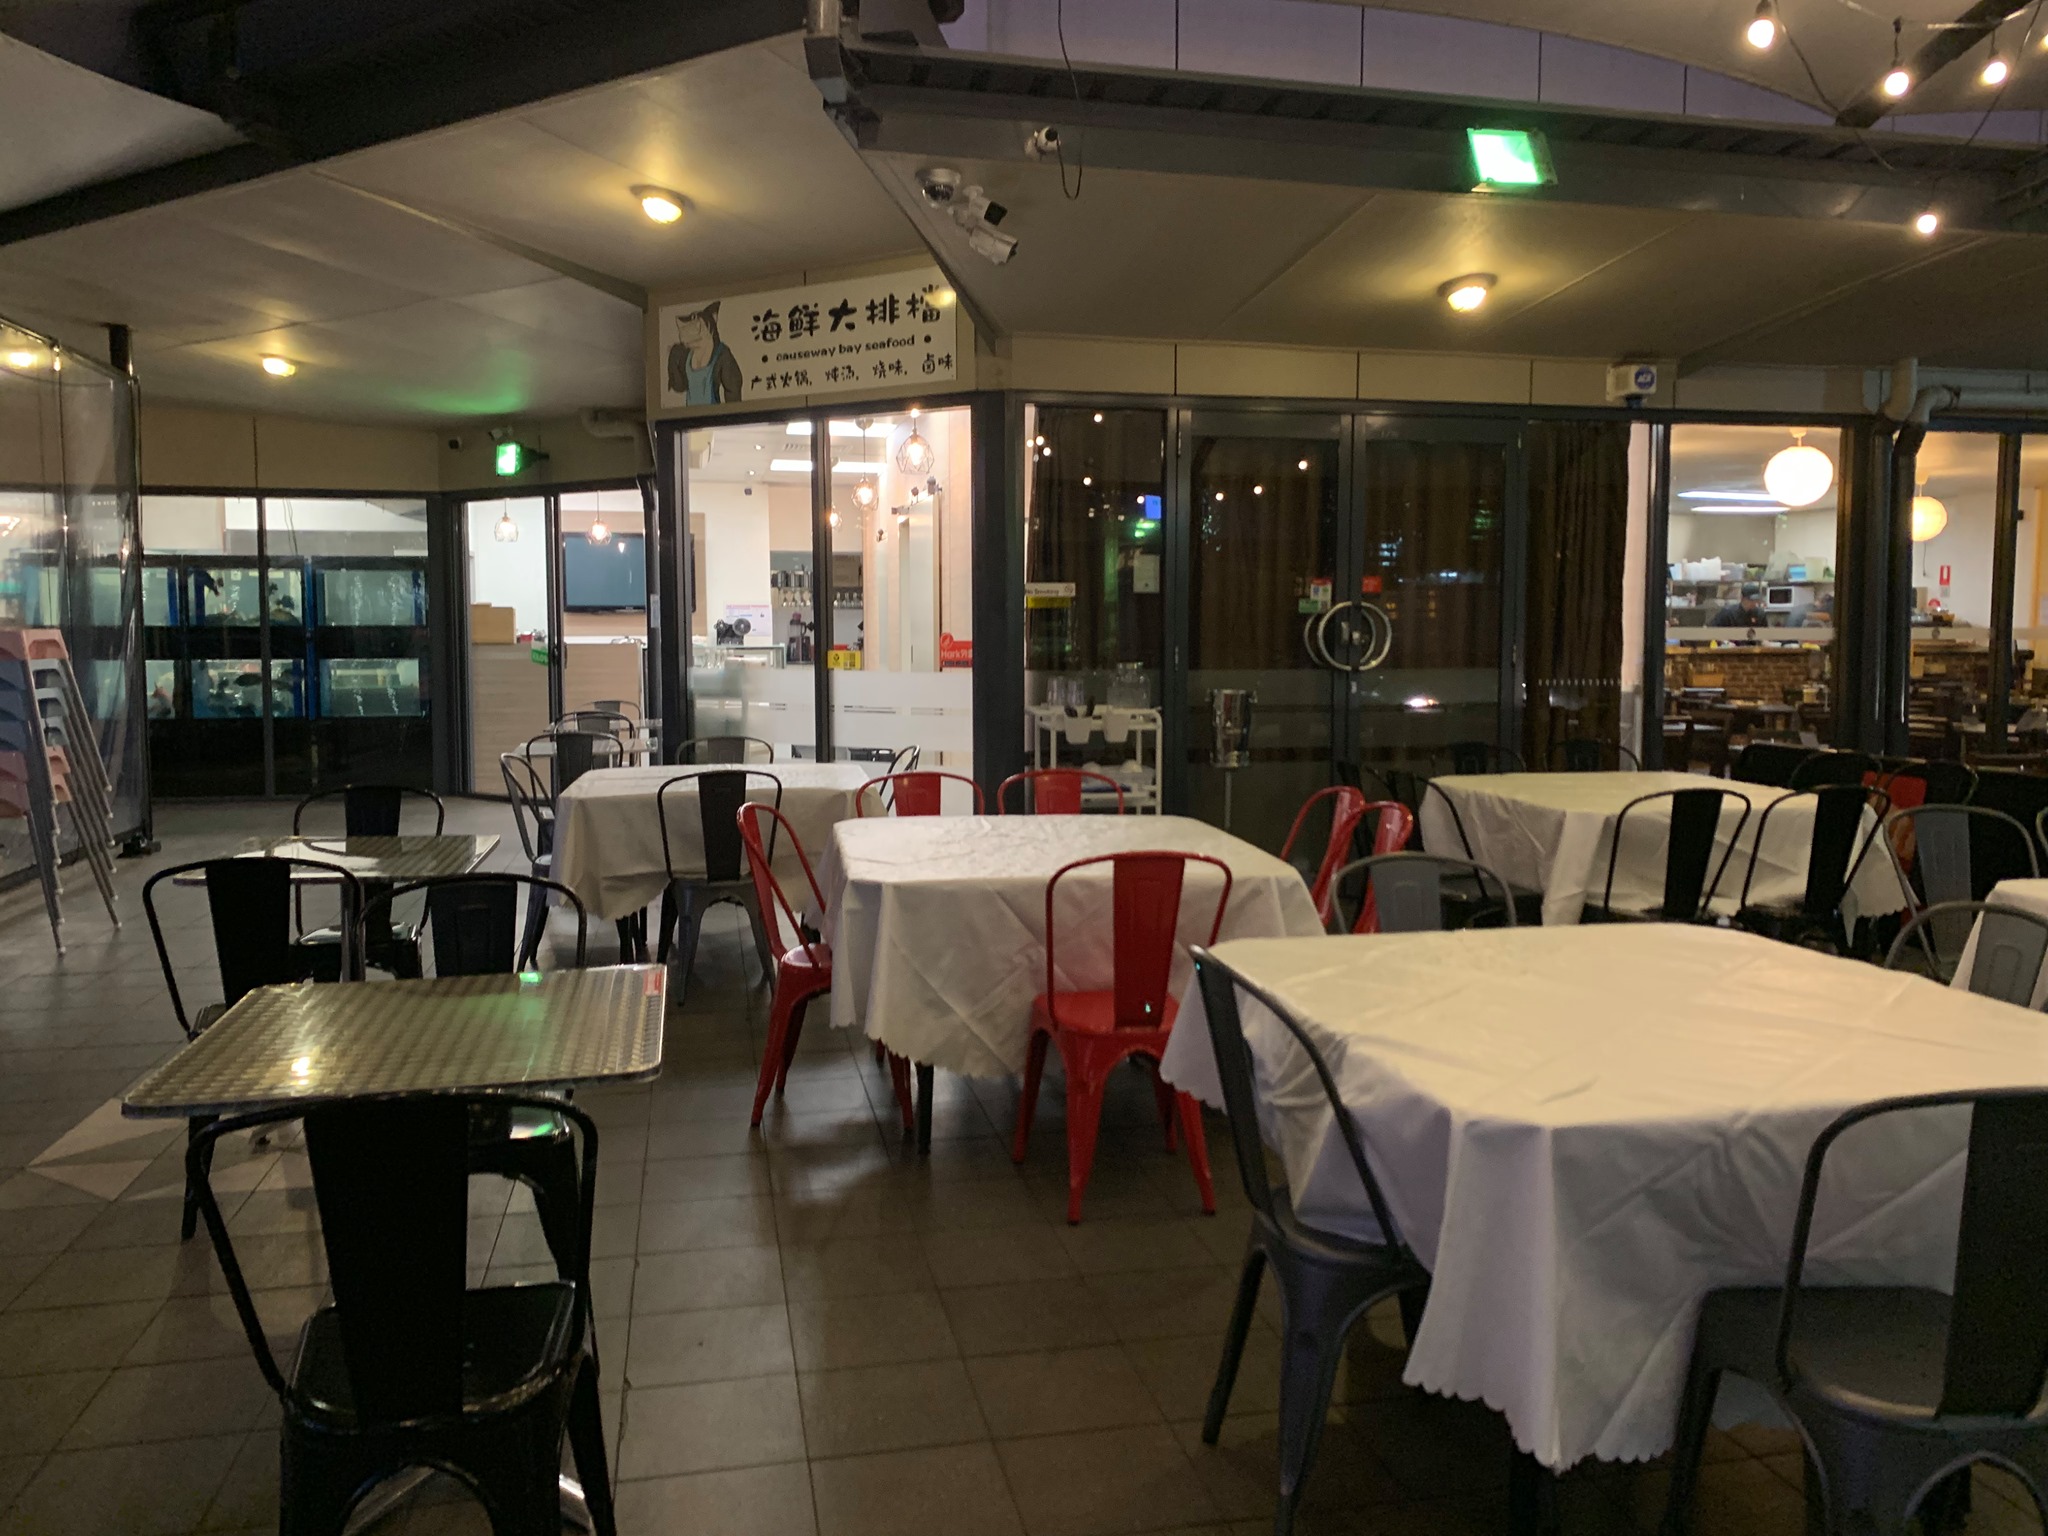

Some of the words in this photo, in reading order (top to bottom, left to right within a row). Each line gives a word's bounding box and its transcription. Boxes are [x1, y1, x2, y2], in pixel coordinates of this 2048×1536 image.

[776, 346, 836, 362] causeway
[838, 343, 862, 355] bay
[865, 334, 915, 352] seafood
